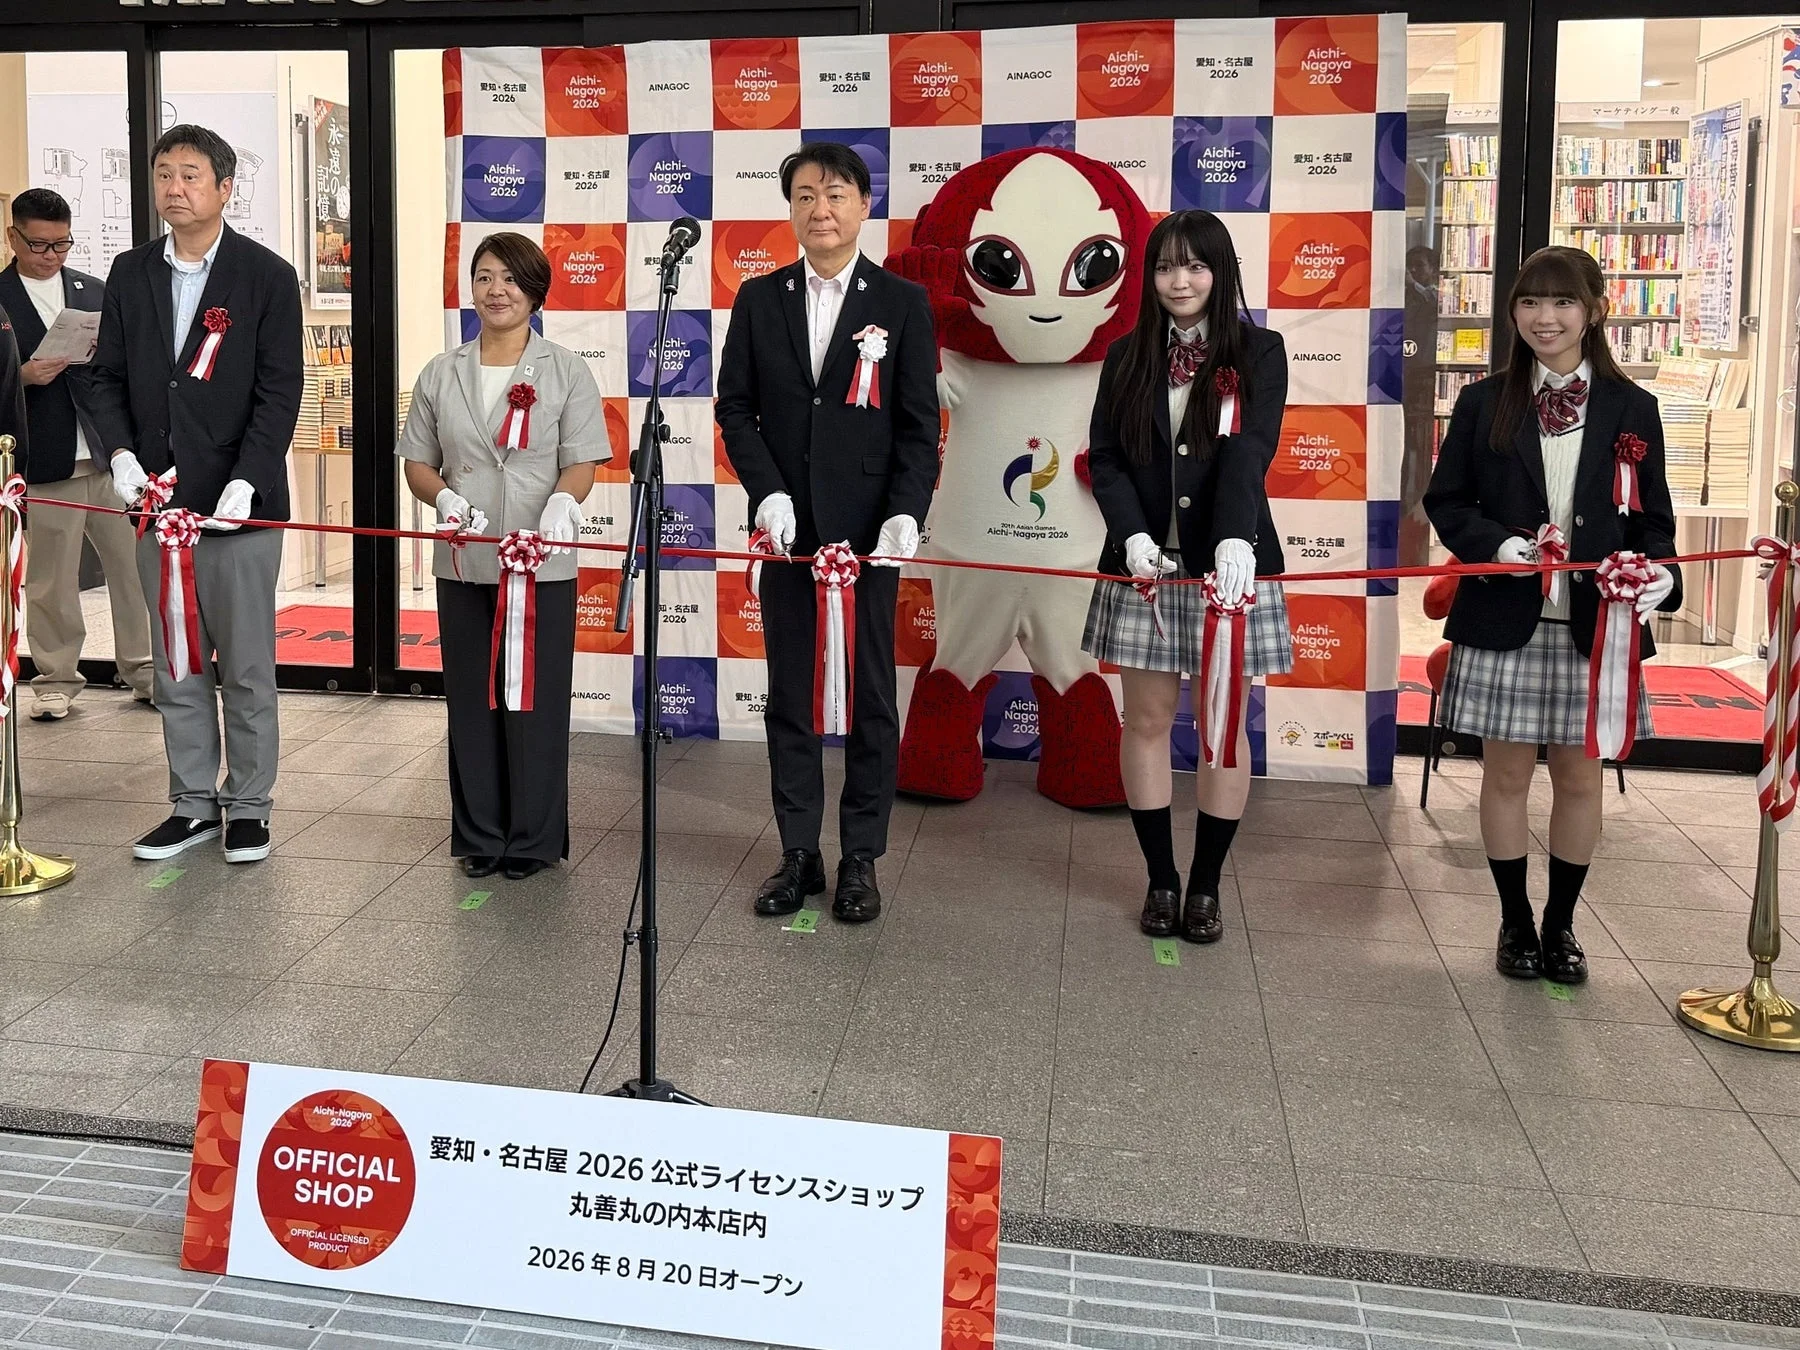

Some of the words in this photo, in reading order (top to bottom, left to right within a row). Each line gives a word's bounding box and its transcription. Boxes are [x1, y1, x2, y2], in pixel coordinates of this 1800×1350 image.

[1107, 51, 1144, 62] Aichi-
[1307, 48, 1346, 59] Aichi-
[1196, 57, 1253, 67] 愛知・名古屋
[1301, 60, 1351, 73] Nagoya
[740, 68, 772, 78] Aichi-
[919, 63, 953, 73] Aichi-
[1102, 63, 1149, 75] Nagoya
[819, 72, 870, 82] 愛知・名古屋
[1007, 71, 1052, 80] AINAGOC
[1210, 69, 1238, 78] 2026
[570, 75, 601, 85] Aichi-
[913, 73, 958, 85] Nagoya
[1109, 77, 1140, 87] 2026
[1309, 74, 1342, 84] 2026
[480, 83, 527, 92] 愛知・名古屋
[649, 83, 690, 92] AINAGOC
[735, 79, 777, 90] Nagoya
[832, 84, 858, 92] 2026
[565, 86, 606, 97] Nagoya
[742, 92, 770, 101] 2026
[921, 87, 950, 97] 2026
[493, 94, 515, 102] 2026
[573, 99, 599, 108] 2026
[1454, 109, 1498, 117] マーケティ
[1593, 106, 1680, 115] マーケティング一般
[328, 117, 344, 195] 永遠の
[1203, 147, 1240, 158] Aichi-
[1294, 153, 1352, 163] 愛知・名古屋
[489, 164, 520, 174] Aichi-
[654, 160, 686, 170] Aichi-
[909, 162, 961, 172] 愛知・名古屋
[1107, 160, 1147, 168] INAGOC
[1197, 158, 1246, 171] Nagoya
[1308, 165, 1337, 174] 2026
[484, 174, 525, 186] Nagoya
[564, 171, 609, 180] 愛知・名古屋
[649, 171, 691, 182] Nagoya
[736, 171, 777, 179] AINAGOC
[922, 174, 948, 183] 2026
[1205, 172, 1237, 183] 2026
[575, 181, 598, 190] 2026
[656, 184, 684, 193] 2026
[317, 164, 331, 222] 記憶
[491, 187, 517, 197] 2026
[739, 248, 771, 259] Aichi-
[1301, 243, 1339, 254] Aichi-
[569, 252, 600, 261] Aichi-
[1295, 255, 1344, 268] Nagoya
[563, 262, 604, 273] Nagoya
[733, 259, 776, 271] Nagoya
[570, 274, 596, 284] 2026
[1303, 269, 1336, 279] 2026
[649, 349, 690, 360] Ngoya
[1293, 353, 1341, 361] AINAGOC
[663, 361, 684, 370] 026
[1296, 435, 1335, 446] Aichi-
[1290, 446, 1340, 458] Nagoya
[1299, 460, 1331, 471] 2026
[585, 516, 614, 525] ・名古屋
[580, 526, 603, 535] 2026
[661, 524, 694, 534] agoya
[987, 528, 1046, 540] Aichi-Nagoya
[660, 535, 687, 544] 2026
[1287, 537, 1345, 547] 愛知・名古屋
[1301, 549, 1329, 558] 2026
[577, 594, 608, 604] Aichi-
[659, 604, 698, 613] 知・名古屋
[743, 600, 761, 610] Aic
[739, 610, 761, 622] Nag
[918, 606, 936, 617] Aic
[579, 617, 606, 626] 2026
[663, 615, 687, 623] 2026
[913, 617, 936, 630] Nag
[1296, 624, 1335, 635] Aichi-
[921, 630, 936, 640] 20
[1291, 635, 1340, 647] Nagoya
[1299, 648, 1331, 659] 2026
[659, 684, 691, 694] Aichi-
[571, 691, 611, 701] AINAGOC
[660, 695, 696, 706] agoya
[735, 693, 768, 702] 愛知・名
[661, 706, 689, 715] 2026
[747, 704, 766, 712] 202
[1010, 700, 1039, 711] Aichi
[1004, 710, 1038, 724] Nago
[1313, 731, 1354, 740] スポーツくじ
[313, 1106, 372, 1120] Aichi-Nagoya
[330, 1118, 352, 1127] 2026
[274, 1146, 401, 1182] OFFICIAL
[294, 1179, 374, 1209] SHOP
[569, 1191, 767, 1239] 丸善丸の内本店内
[290, 1228, 327, 1241] OFFICIAL
[330, 1233, 369, 1245] LICENSED
[308, 1241, 349, 1253] PRODUCT
